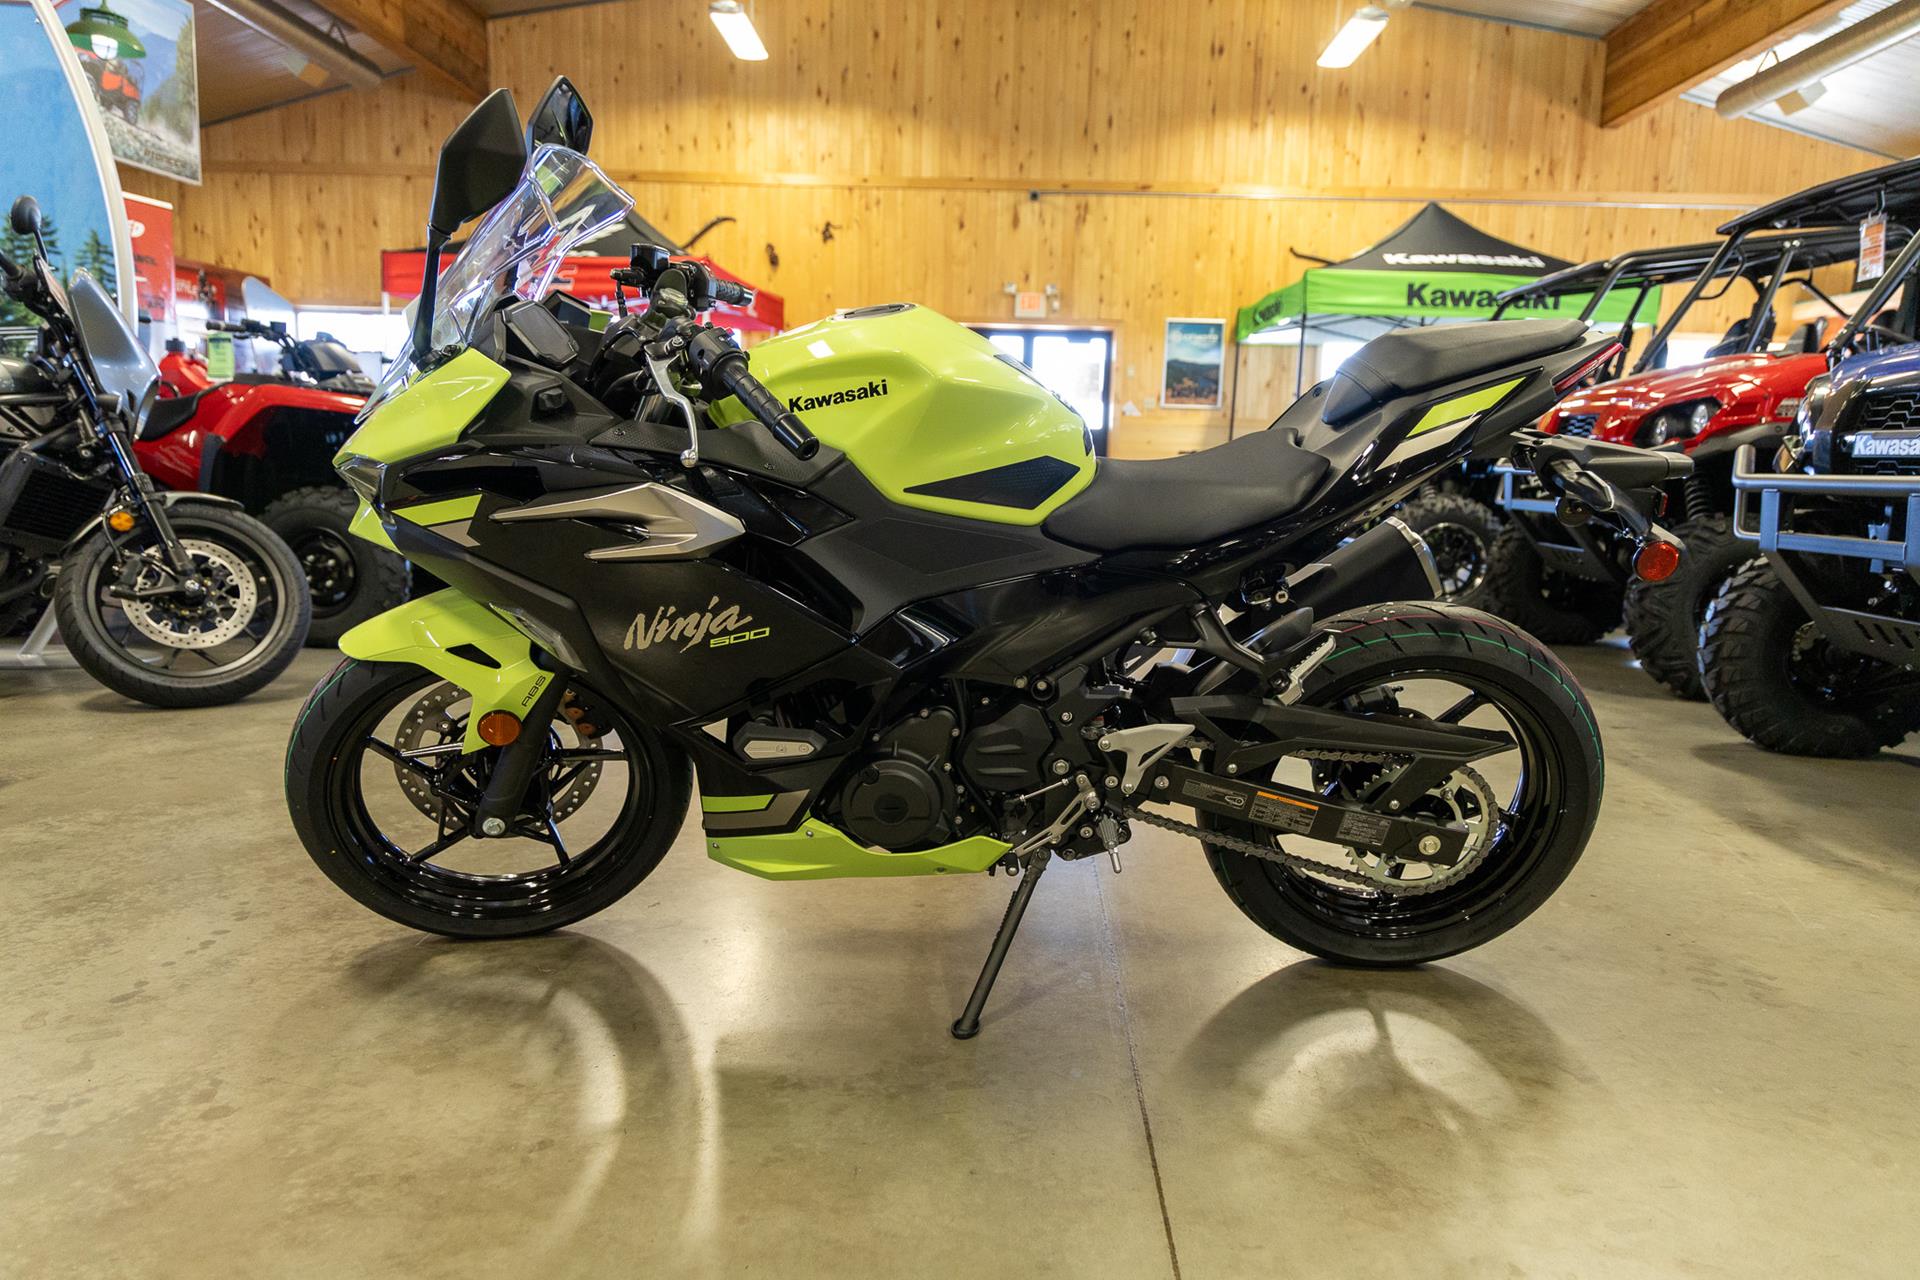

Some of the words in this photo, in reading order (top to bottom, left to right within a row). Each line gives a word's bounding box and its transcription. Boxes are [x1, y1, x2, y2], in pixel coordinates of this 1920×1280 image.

[1407, 282, 1560, 310] Kawaaki
[788, 379, 888, 413] Kawasaki
[624, 595, 752, 653] Ninja
[709, 627, 770, 648] 500
[521, 675, 546, 707] ABS
